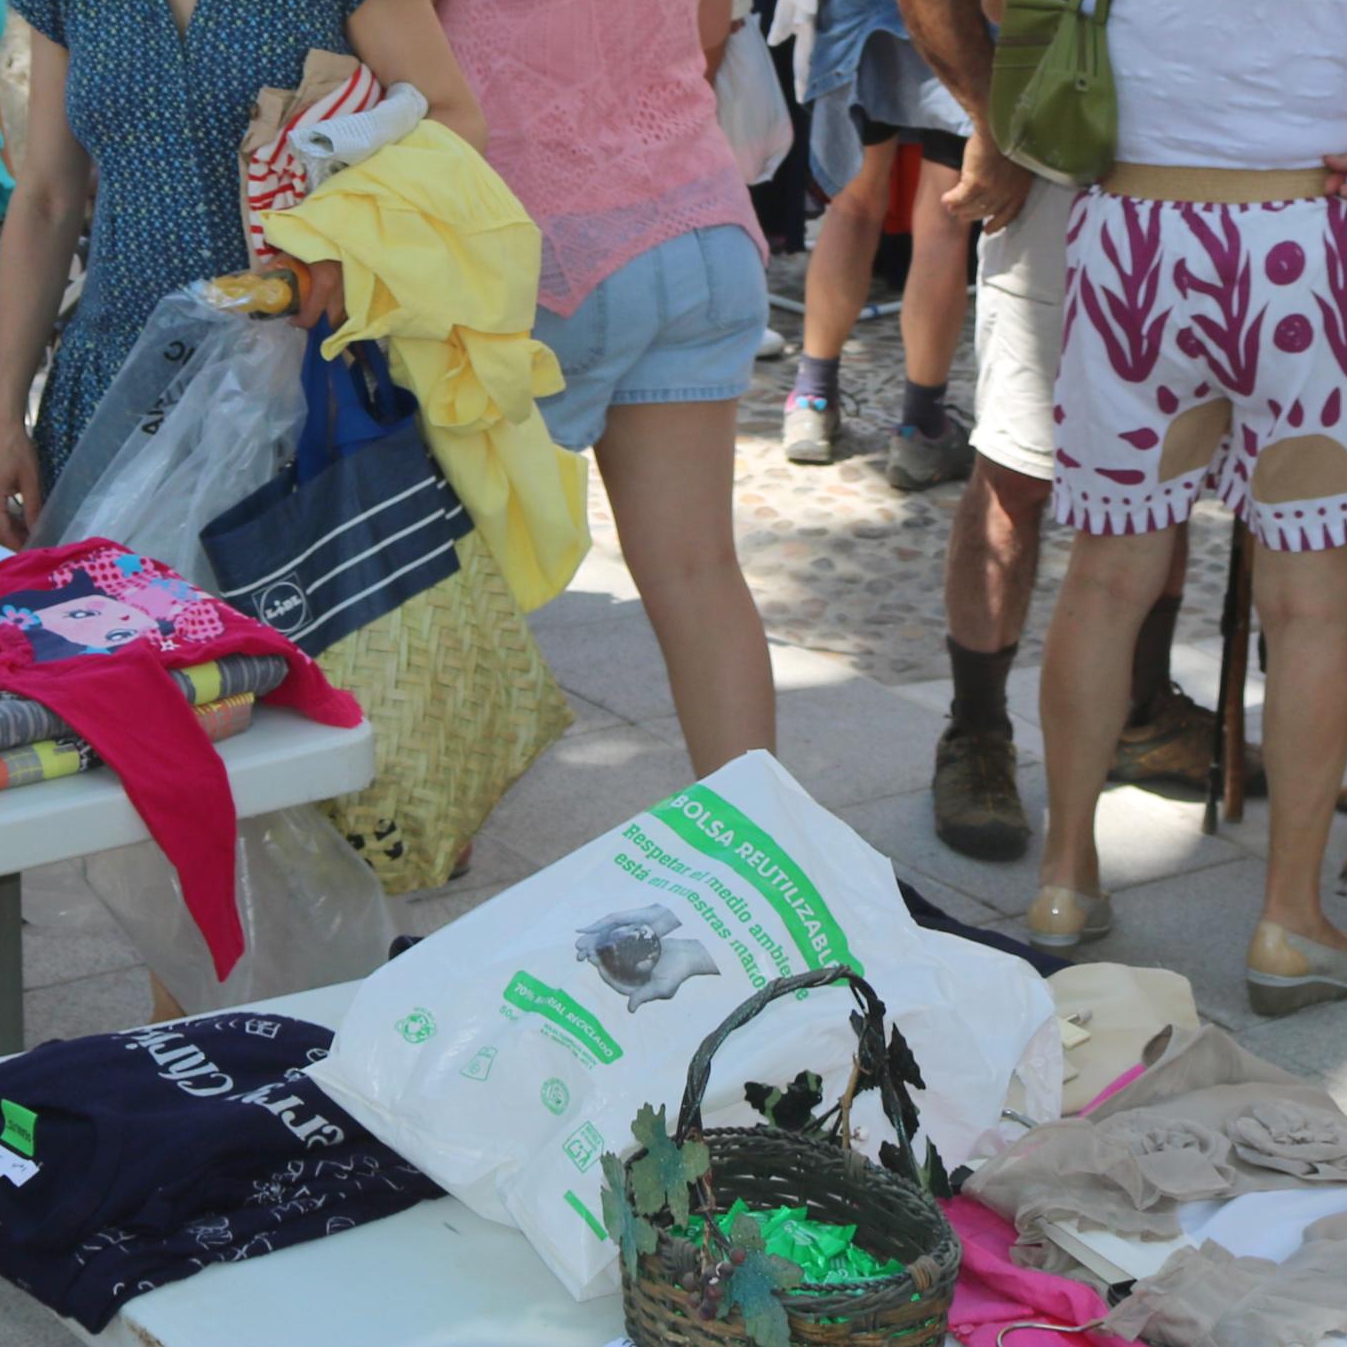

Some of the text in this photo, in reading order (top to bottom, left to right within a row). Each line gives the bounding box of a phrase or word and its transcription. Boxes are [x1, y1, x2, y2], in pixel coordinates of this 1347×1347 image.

[670, 793, 735, 848] BOLSA
[613, 852, 650, 882] está
[667, 880, 732, 941] nuestras
[621, 822, 690, 881] Respetar
[706, 876, 753, 925] medio
[565, 1012, 613, 1057] RECICLADO
